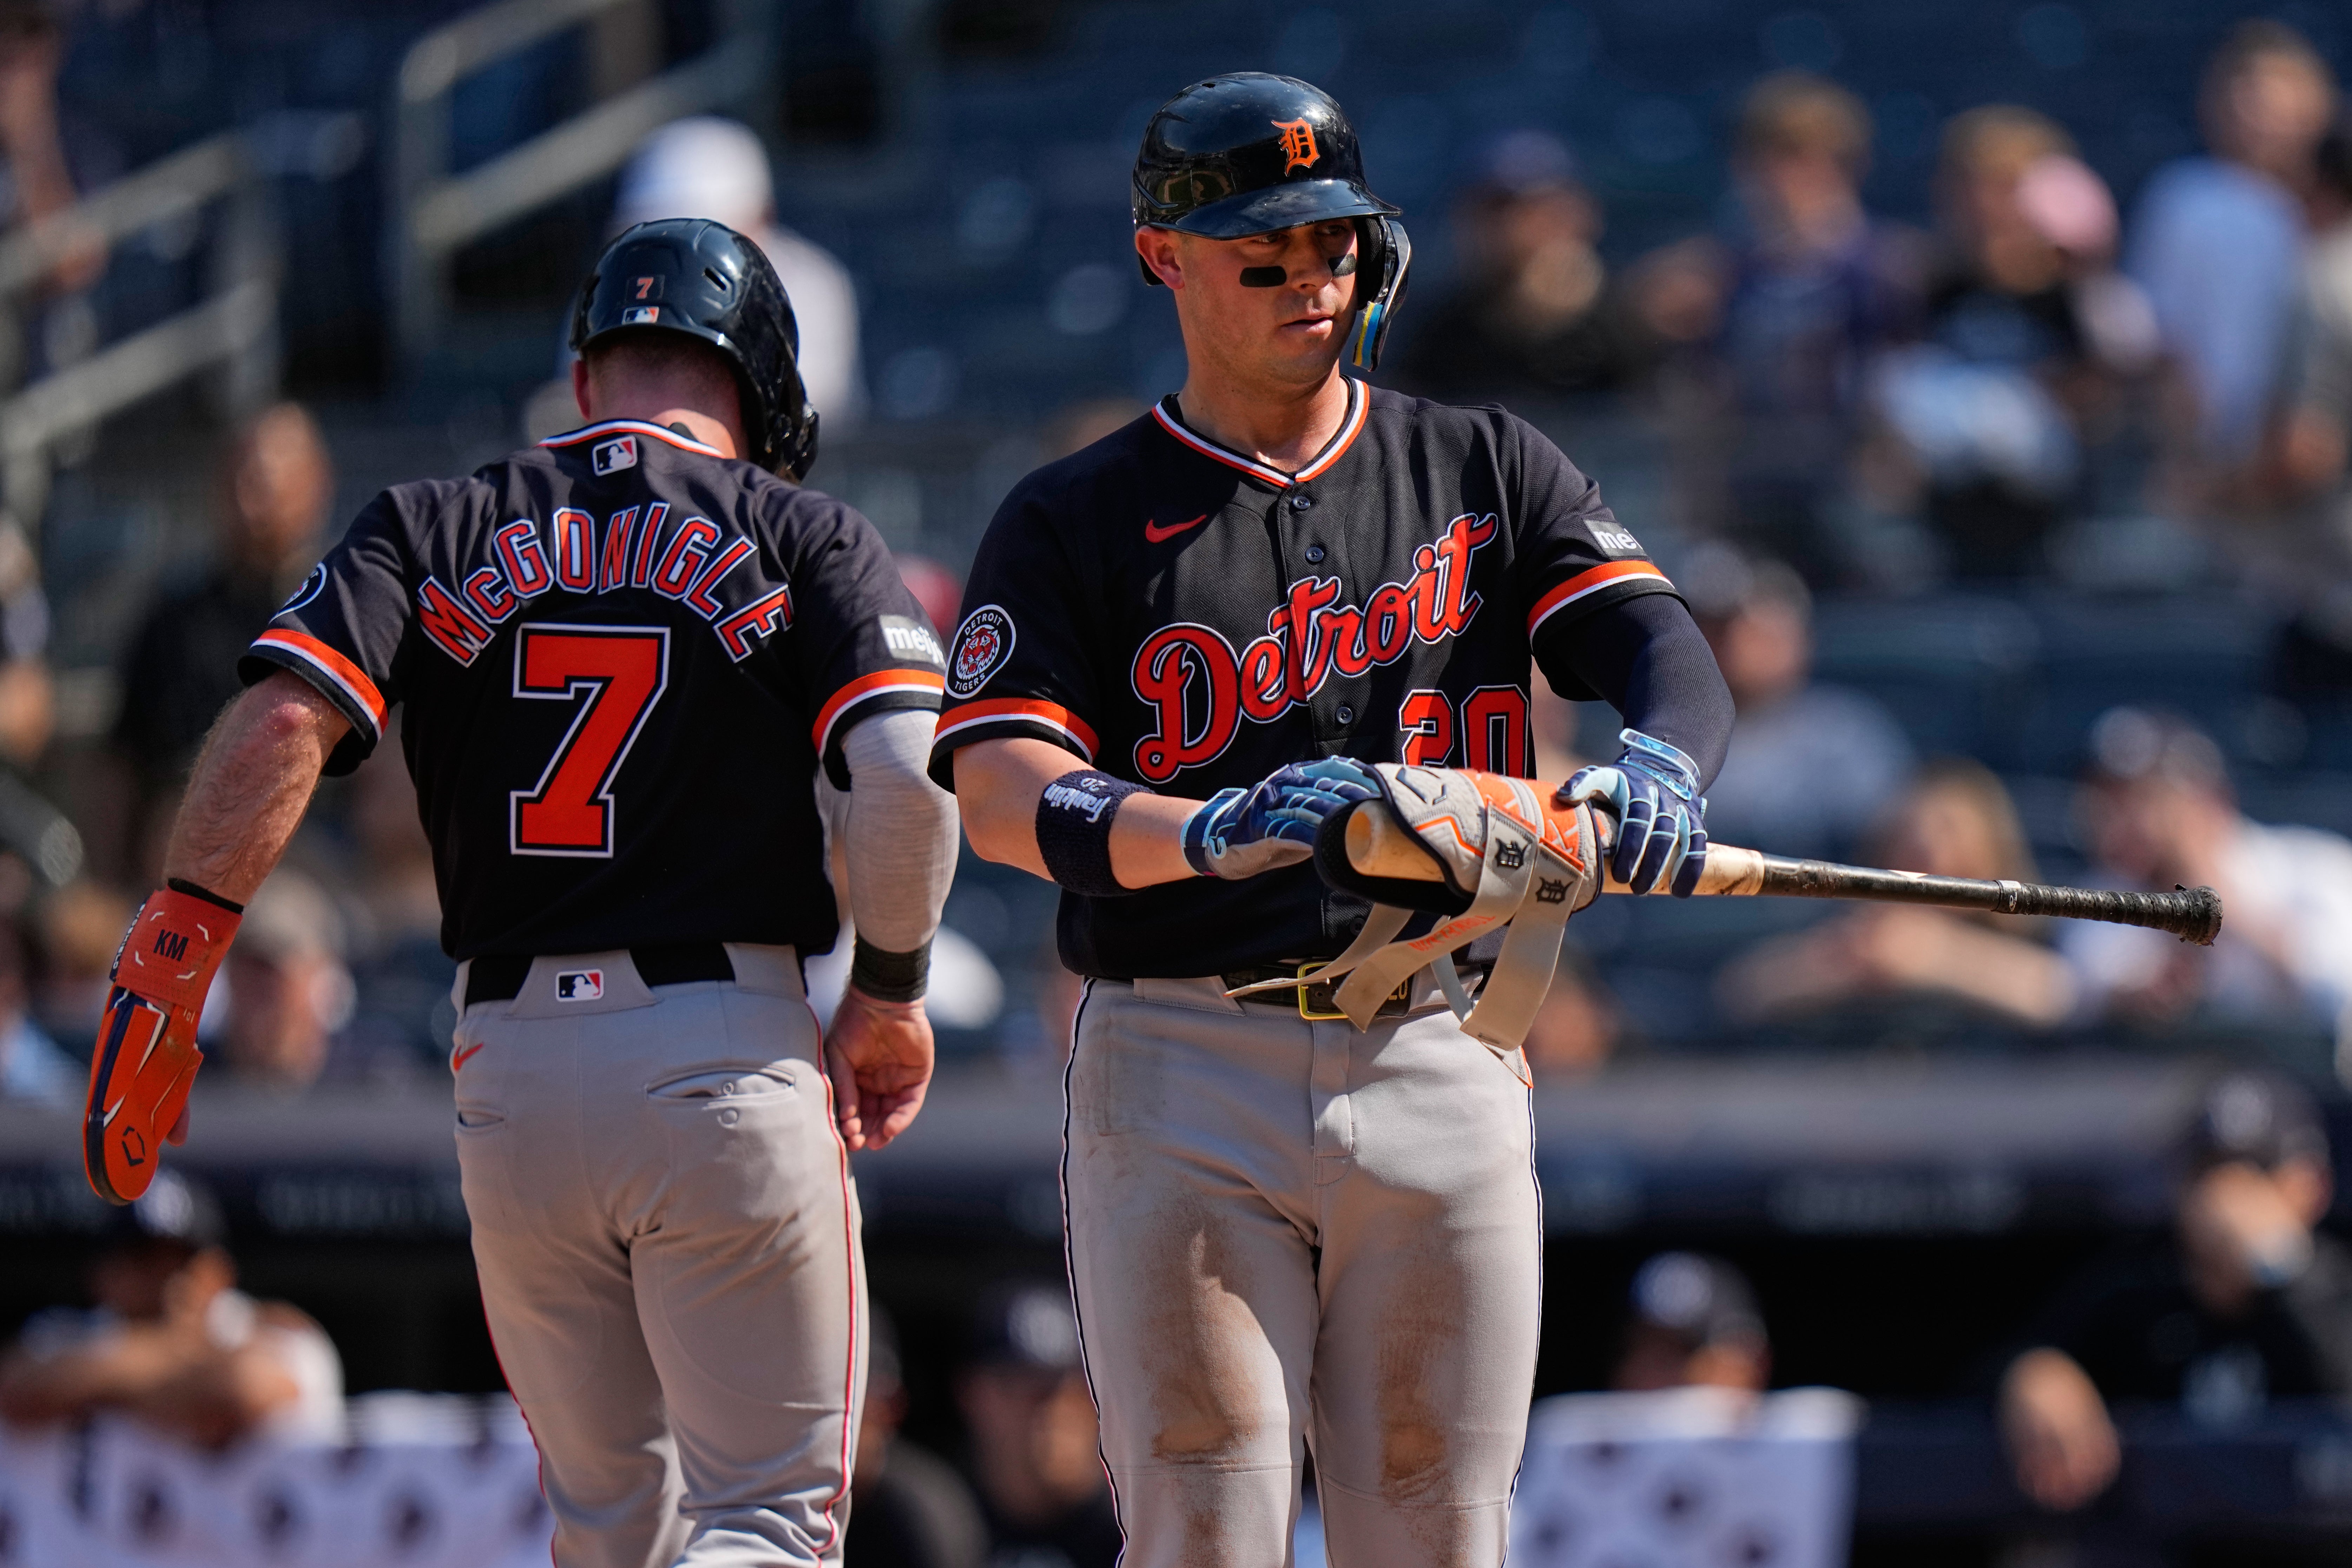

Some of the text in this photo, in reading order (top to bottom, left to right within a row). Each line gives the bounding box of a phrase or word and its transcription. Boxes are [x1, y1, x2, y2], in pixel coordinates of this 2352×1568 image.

[1271, 117, 1320, 177] D
[636, 277, 654, 299] 7
[417, 502, 795, 667] McGONIGLE
[964, 613, 1003, 636] DETROIT
[1131, 513, 1498, 784] Detroit
[955, 672, 985, 691] TIGERS
[510, 622, 671, 858] 7
[1399, 684, 1529, 779] 20
[1081, 777, 1108, 791] 20
[153, 929, 189, 962] KM
